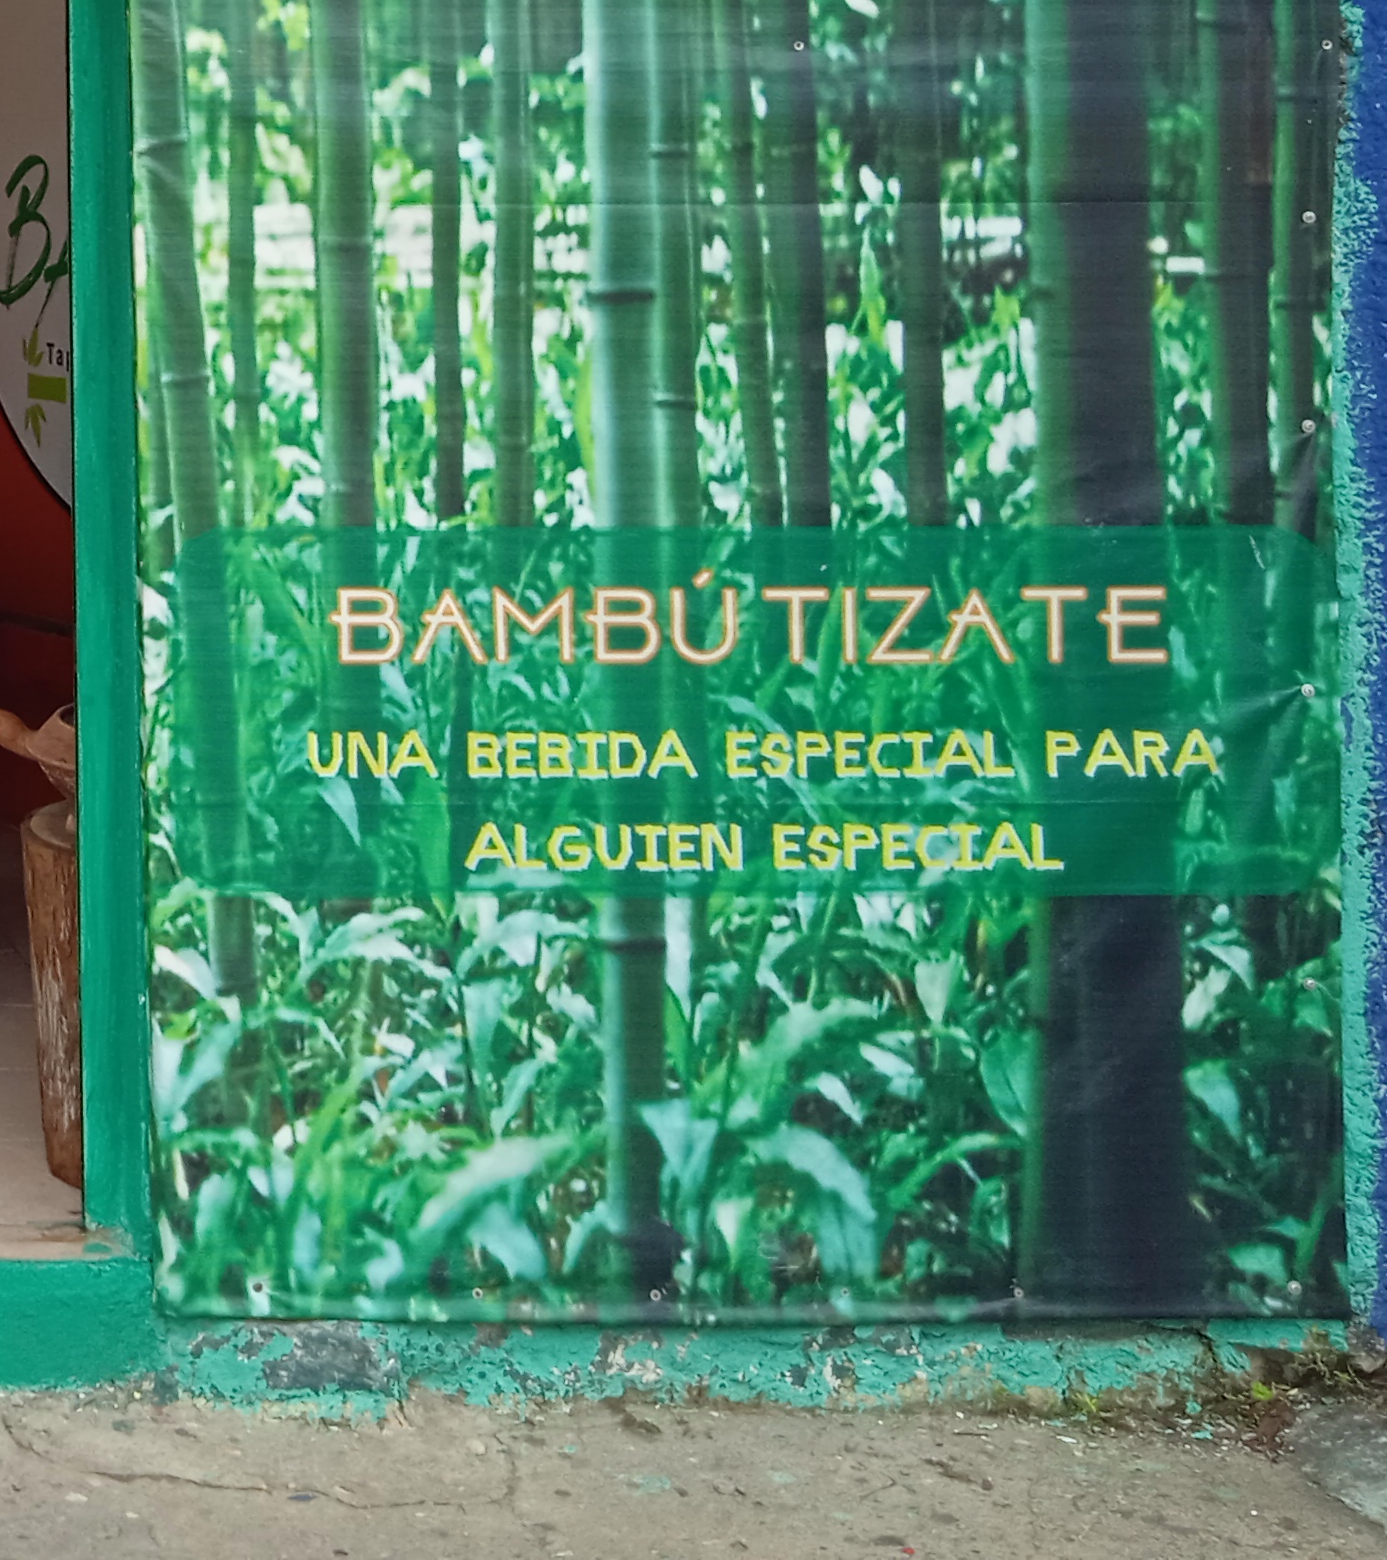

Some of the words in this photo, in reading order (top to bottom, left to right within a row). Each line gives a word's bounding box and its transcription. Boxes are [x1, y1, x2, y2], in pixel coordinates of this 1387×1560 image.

[307, 730, 438, 778] UNA
[467, 730, 698, 779] BEBIDA
[726, 730, 1015, 778] ESPECIAL
[1046, 729, 1220, 777] PARA
[465, 822, 745, 871] ALGUIEN
[773, 823, 1065, 871] ESPECIAL
